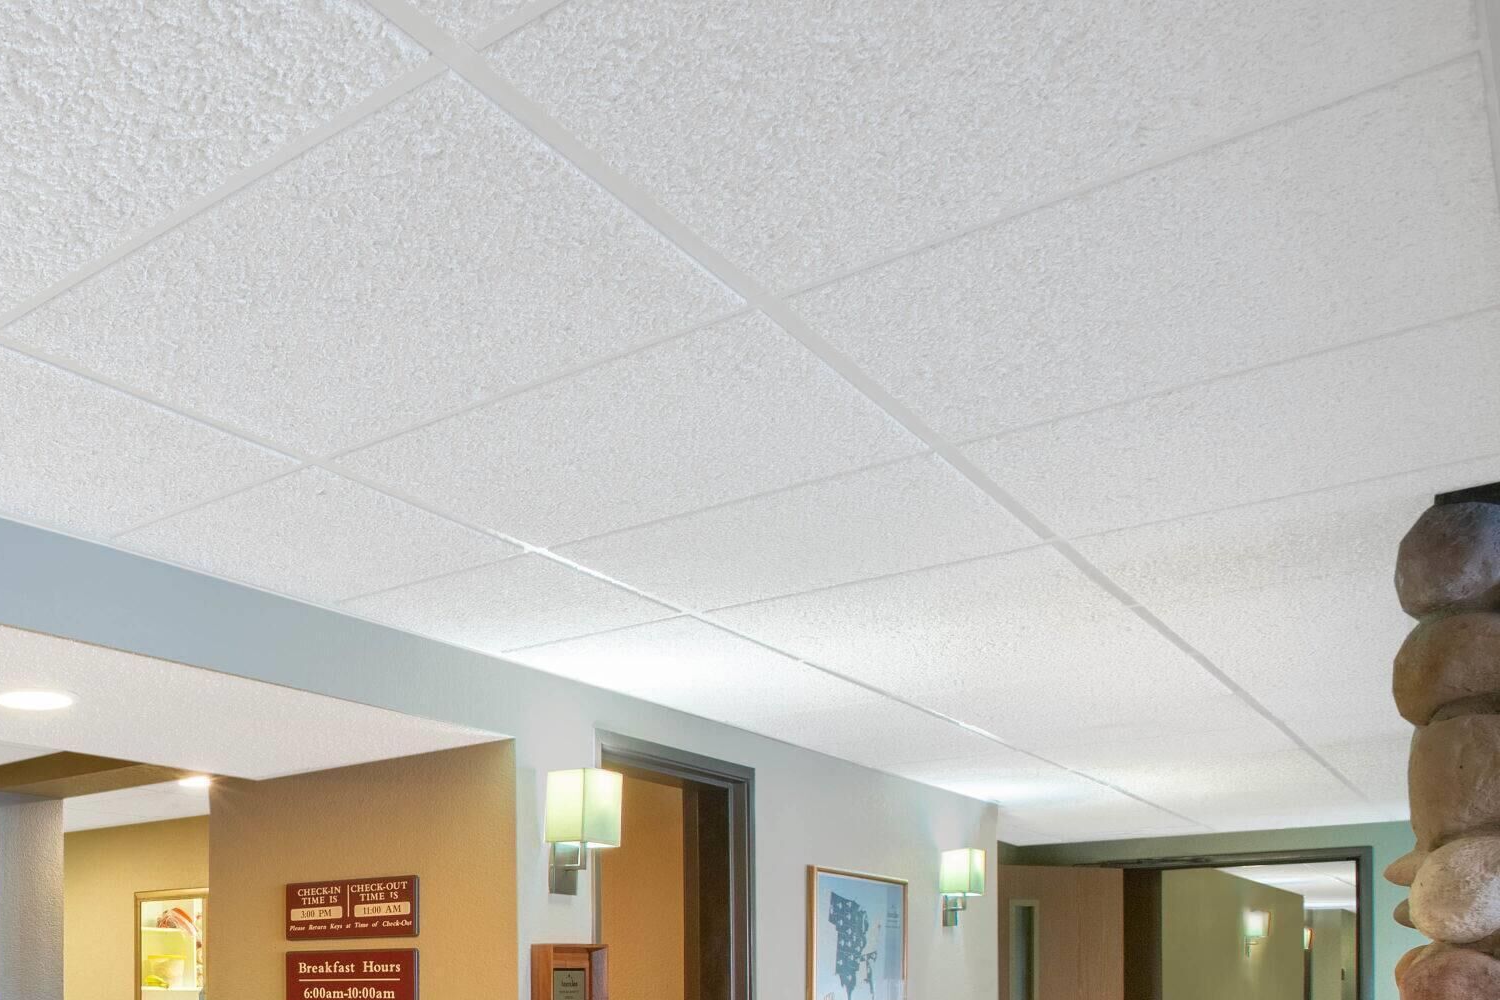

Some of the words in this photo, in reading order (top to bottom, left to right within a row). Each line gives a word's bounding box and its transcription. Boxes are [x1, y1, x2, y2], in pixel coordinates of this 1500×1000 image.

[298, 886, 341, 897] CHECK-IN
[350, 881, 408, 893] CHECK-OUT
[301, 897, 325, 905] TIME
[359, 892, 385, 901] TIME
[301, 910, 315, 918] 3:00
[318, 909, 332, 917] PM
[363, 906, 381, 914] 11:00
[385, 905, 401, 913] AM
[298, 962, 355, 974] Breakfast
[363, 961, 400, 972] Hours
[304, 988, 395, 999] 6:00am-10:00am
